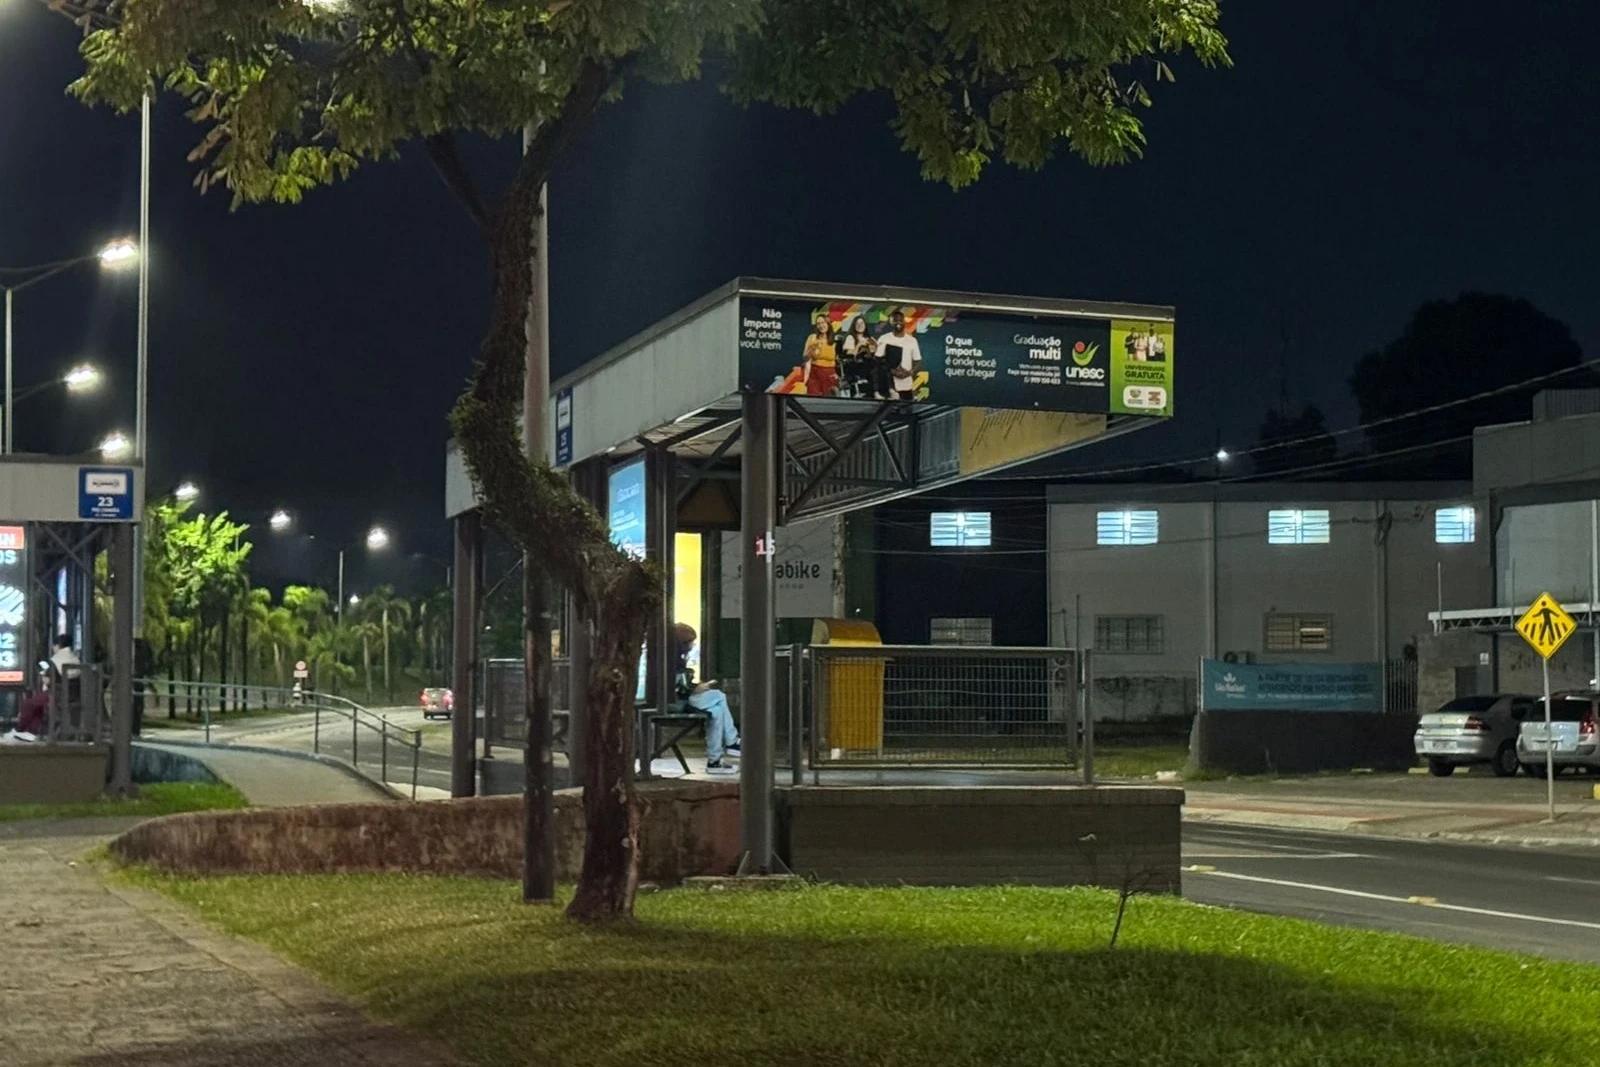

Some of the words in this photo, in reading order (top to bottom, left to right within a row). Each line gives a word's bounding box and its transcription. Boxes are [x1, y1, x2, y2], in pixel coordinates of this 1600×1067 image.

[762, 308, 782, 319] Não
[743, 317, 782, 329] importa
[745, 329, 758, 338] de
[758, 329, 782, 340] onde
[740, 339, 761, 349] você
[762, 341, 782, 350] vem
[945, 335, 953, 344] O
[954, 337, 972, 347] que
[1013, 334, 1061, 347] Graduação
[945, 347, 983, 358] importa
[1029, 348, 1061, 361] multi
[945, 357, 951, 365] é
[952, 357, 975, 367] onde
[976, 358, 997, 368] você
[945, 368, 964, 377] quer
[964, 367, 997, 379] chegar
[1065, 366, 1105, 380] unesc
[1124, 371, 1165, 381] GRATUITA
[97, 496, 114, 507] 23
